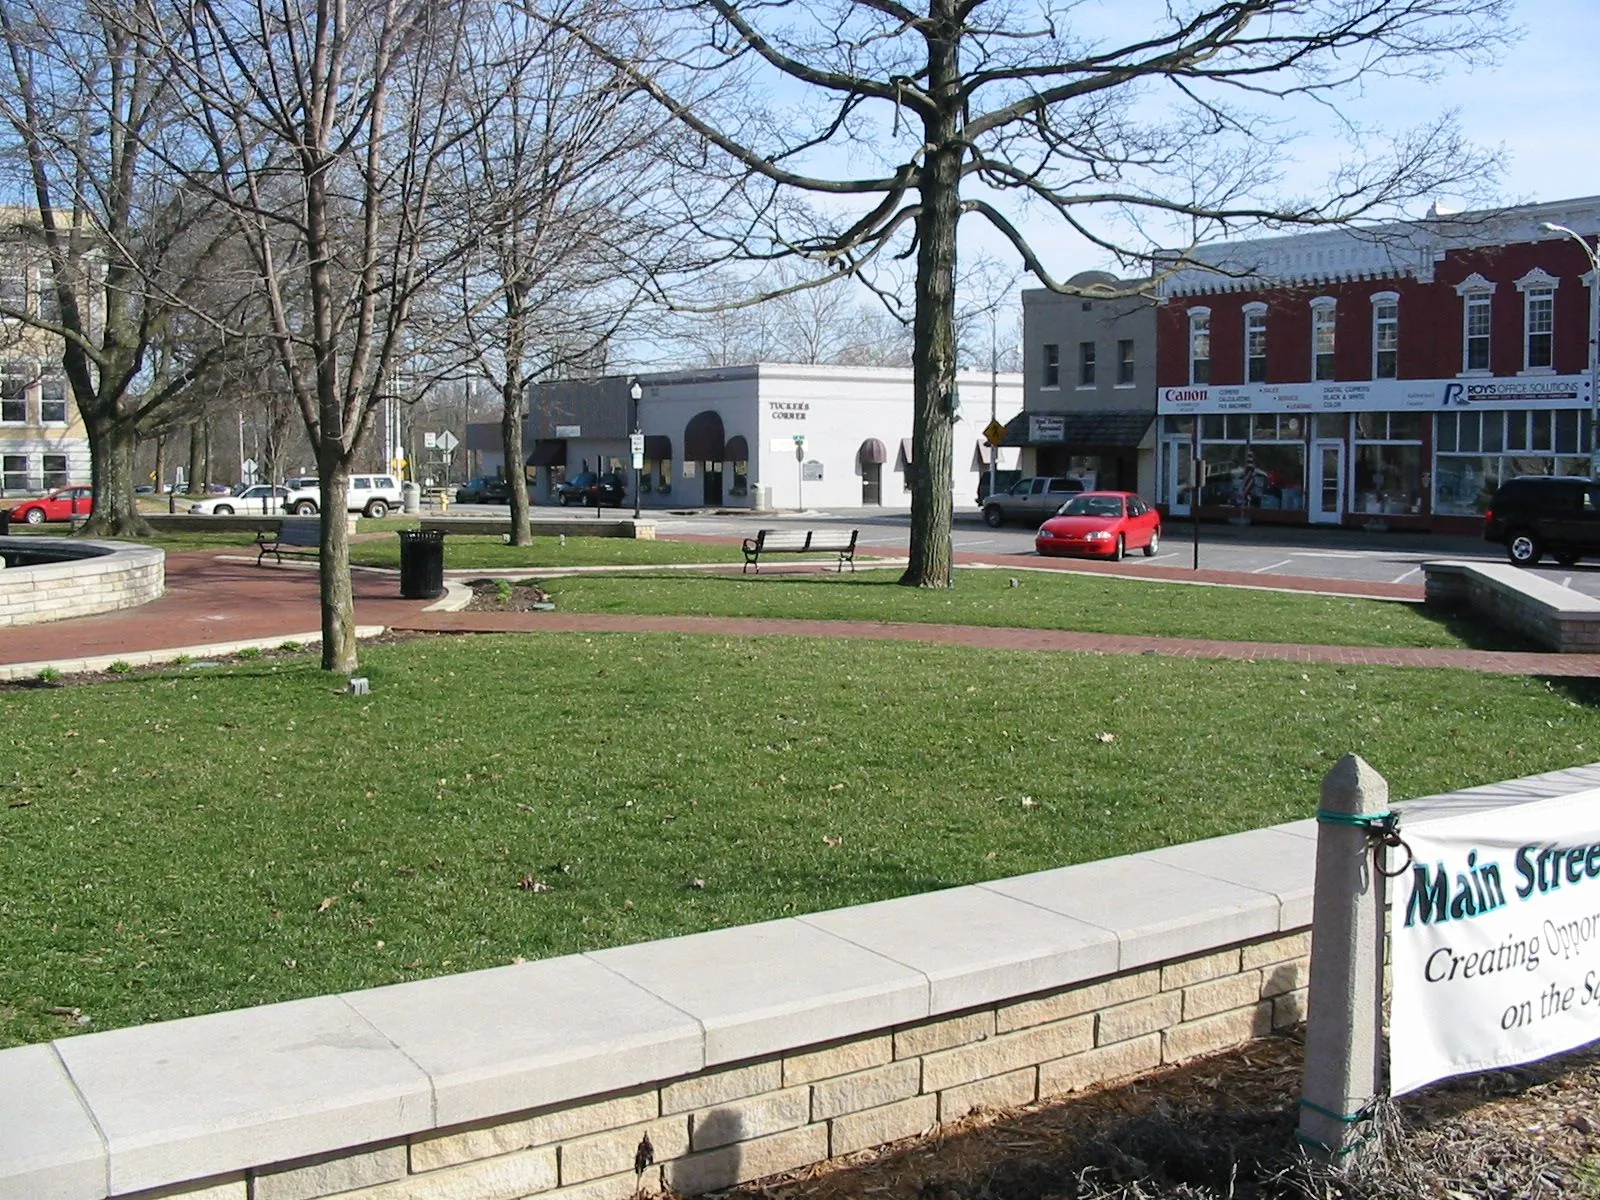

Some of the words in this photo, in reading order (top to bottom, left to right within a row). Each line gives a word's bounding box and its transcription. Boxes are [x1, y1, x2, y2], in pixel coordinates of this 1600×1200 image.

[1165, 389, 1208, 402] Canon
[1467, 384, 1496, 394] ROY'S
[1497, 383, 1527, 393] OFFICE
[1530, 382, 1578, 392] SOLUTIONS
[771, 411, 806, 419] CORNER
[1402, 849, 1507, 930] Main
[1515, 840, 1600, 902] Stree
[1424, 933, 1540, 983] Creating
[1543, 911, 1600, 960] Oppor
[1500, 1000, 1533, 1031] on
[1540, 981, 1575, 1020] the
